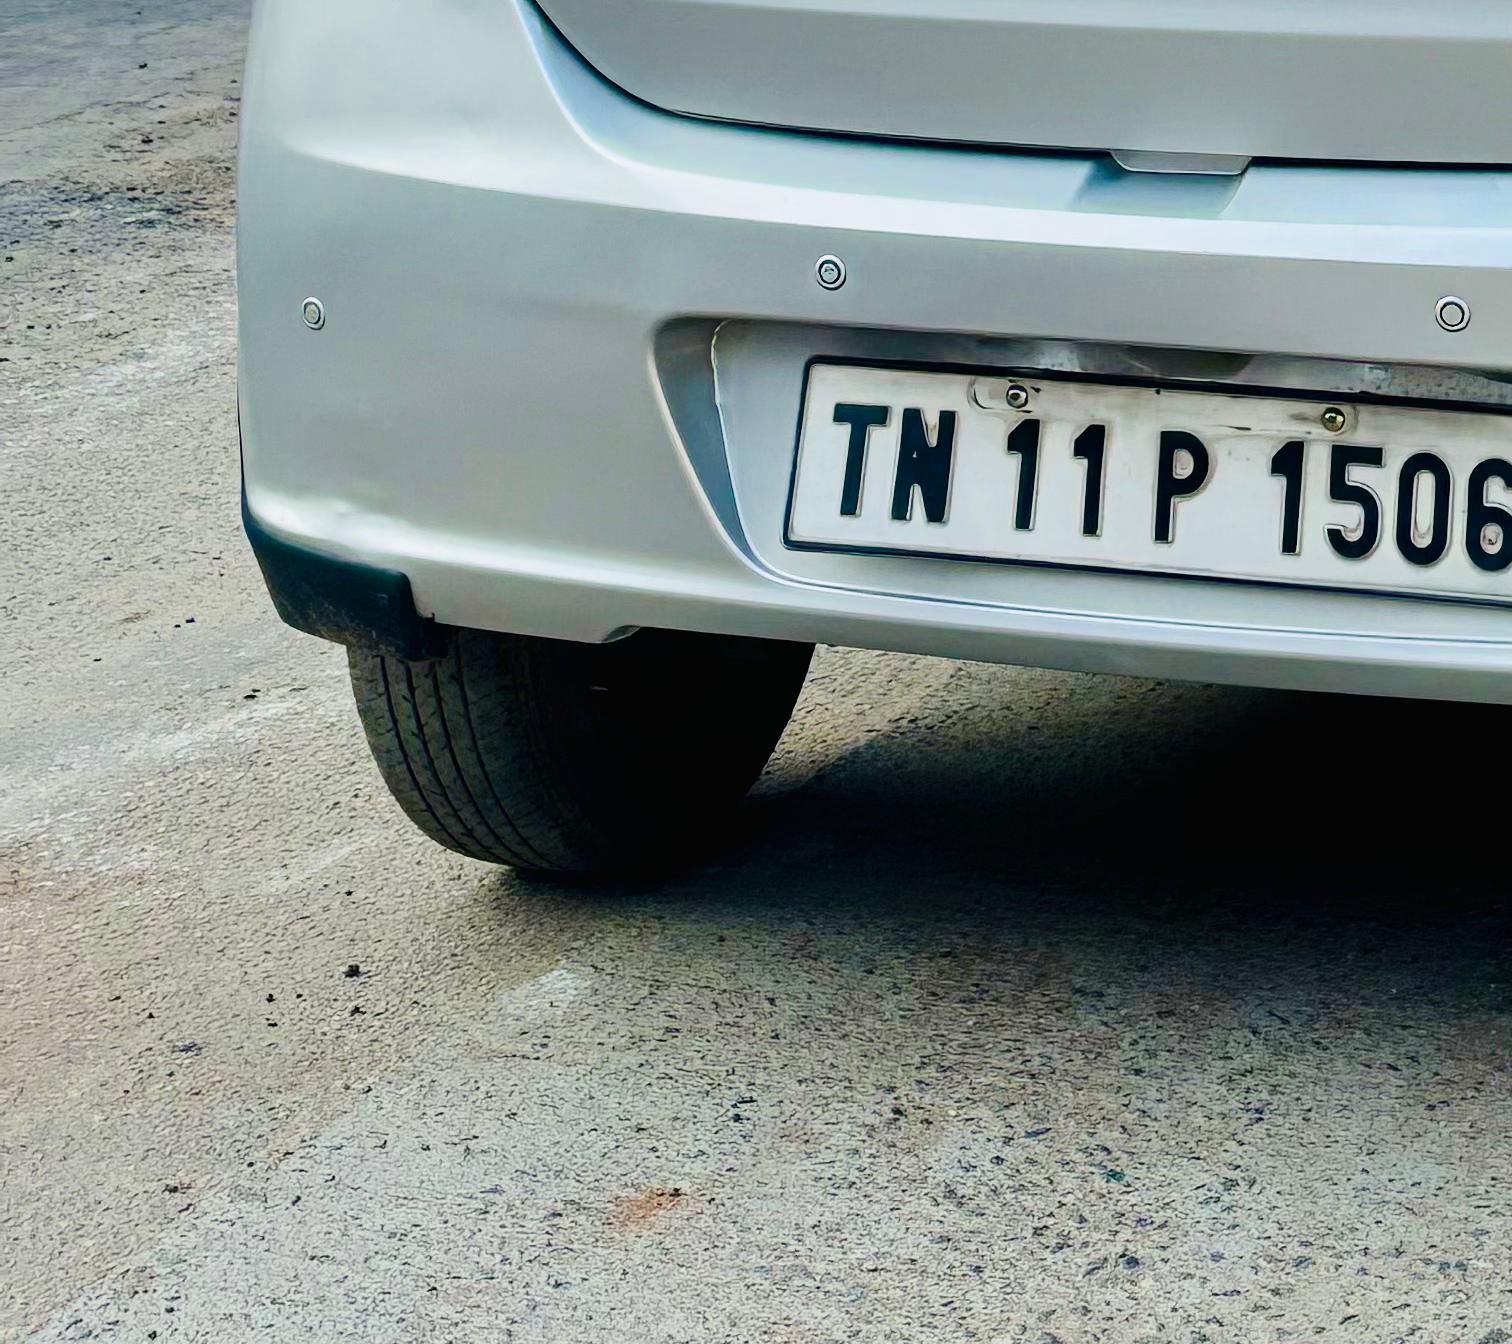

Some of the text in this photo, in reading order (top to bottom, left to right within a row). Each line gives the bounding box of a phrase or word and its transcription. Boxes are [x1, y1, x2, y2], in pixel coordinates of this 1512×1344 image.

[832, 401, 957, 525] TN
[1006, 417, 1107, 539] 11
[1153, 429, 1211, 544] P
